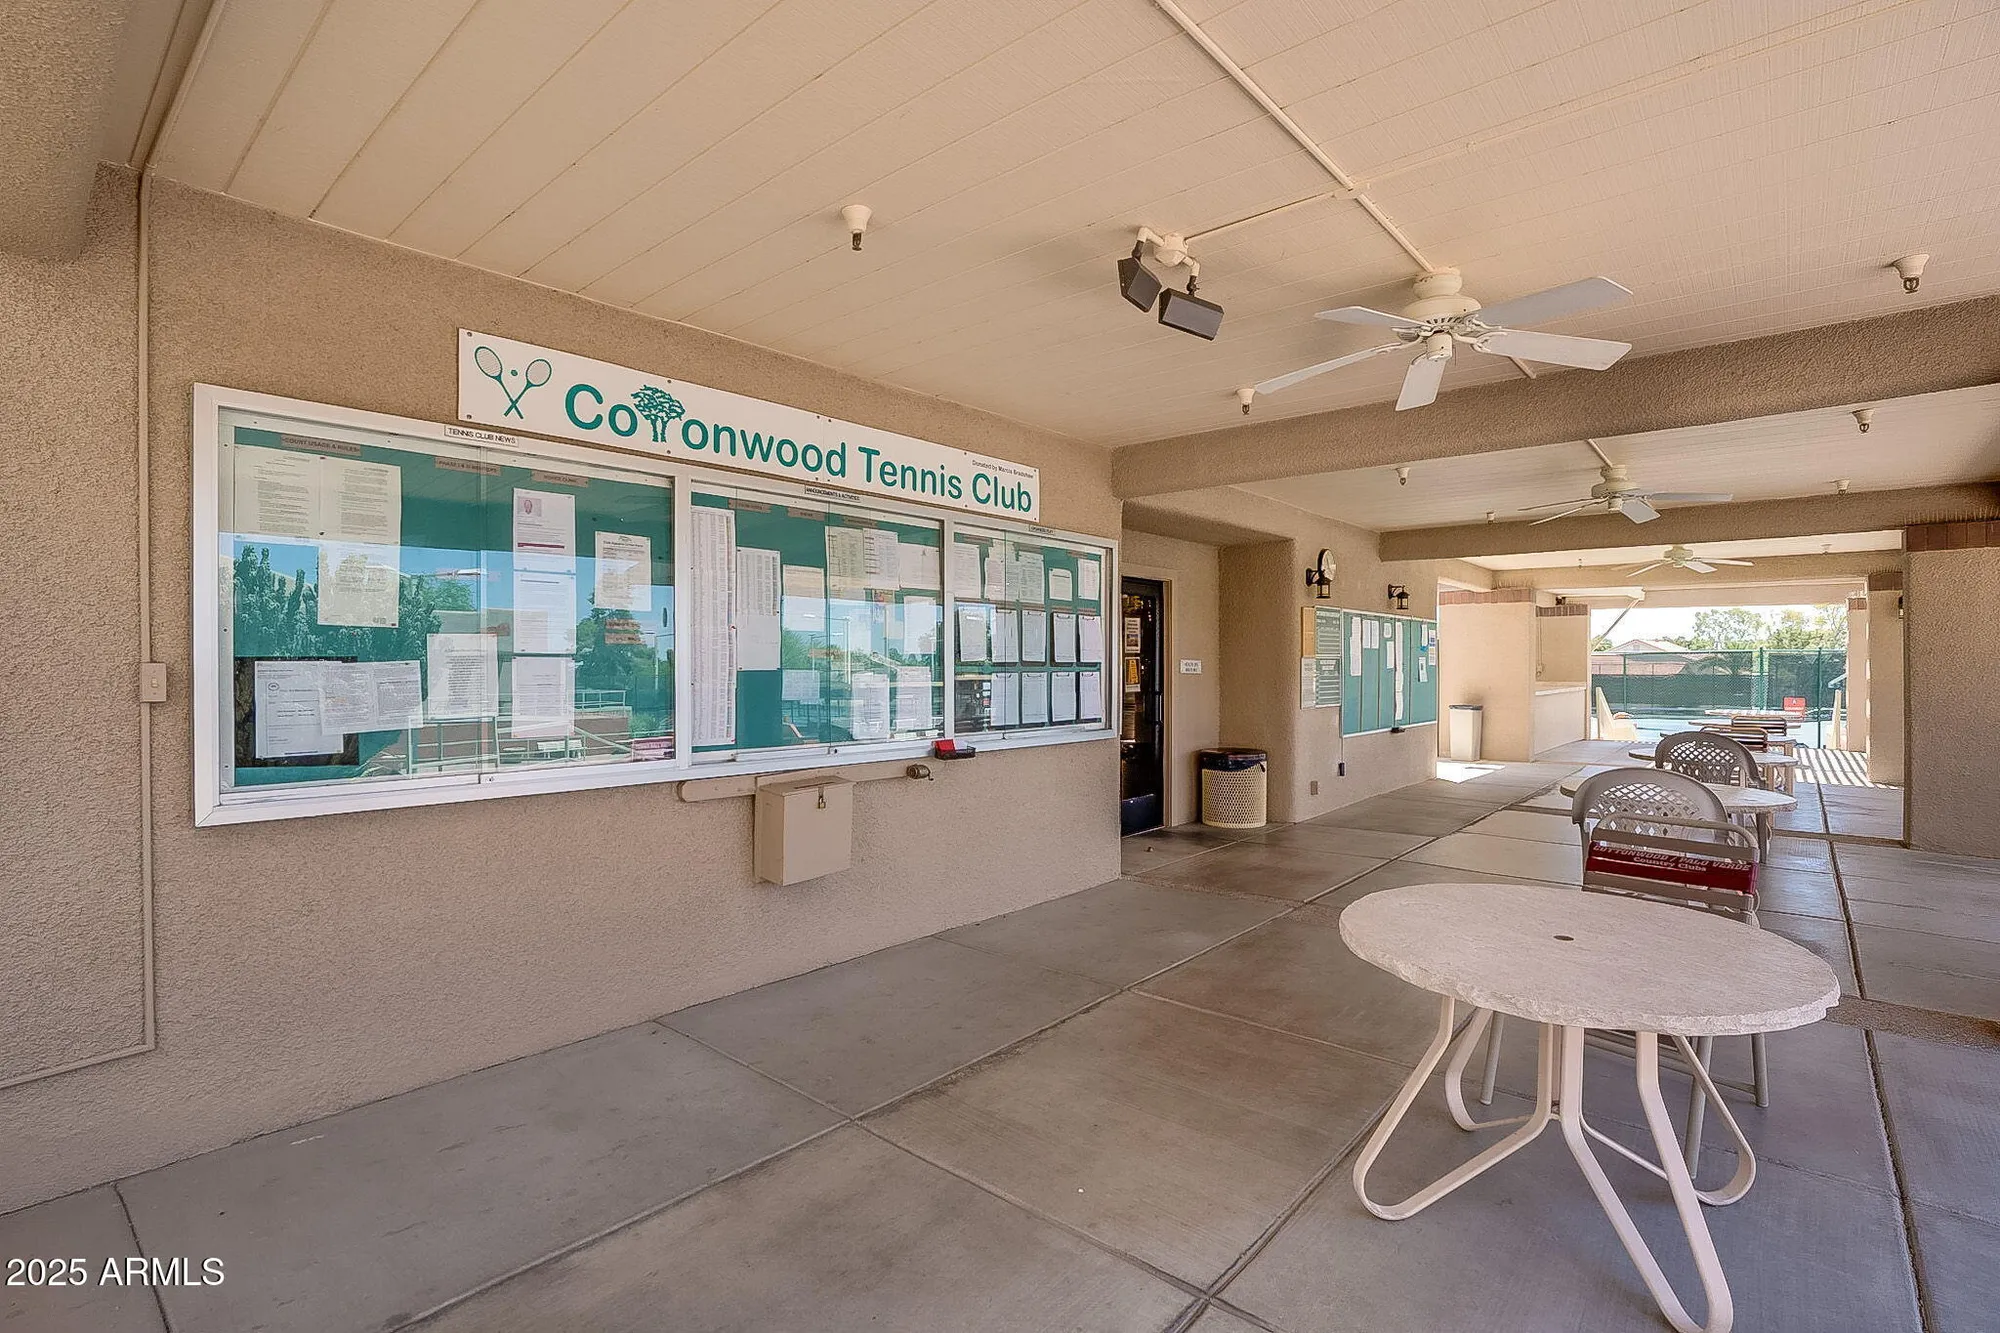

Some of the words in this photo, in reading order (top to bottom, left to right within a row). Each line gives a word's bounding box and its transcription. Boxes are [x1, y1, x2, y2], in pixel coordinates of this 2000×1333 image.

[448, 427, 474, 438] TENNIS
[475, 431, 494, 441] CLUB
[495, 435, 516, 444] NEWS
[972, 460, 991, 470] Donated
[858, 446, 963, 499] Tennis
[972, 473, 1032, 512] Club
[1593, 845, 1669, 860] COTTONWOOD
[1680, 857, 1709, 866] PALO
[1712, 861, 1751, 871] VERDE
[1634, 857, 1675, 867] Country
[1678, 863, 1706, 872] Clubs
